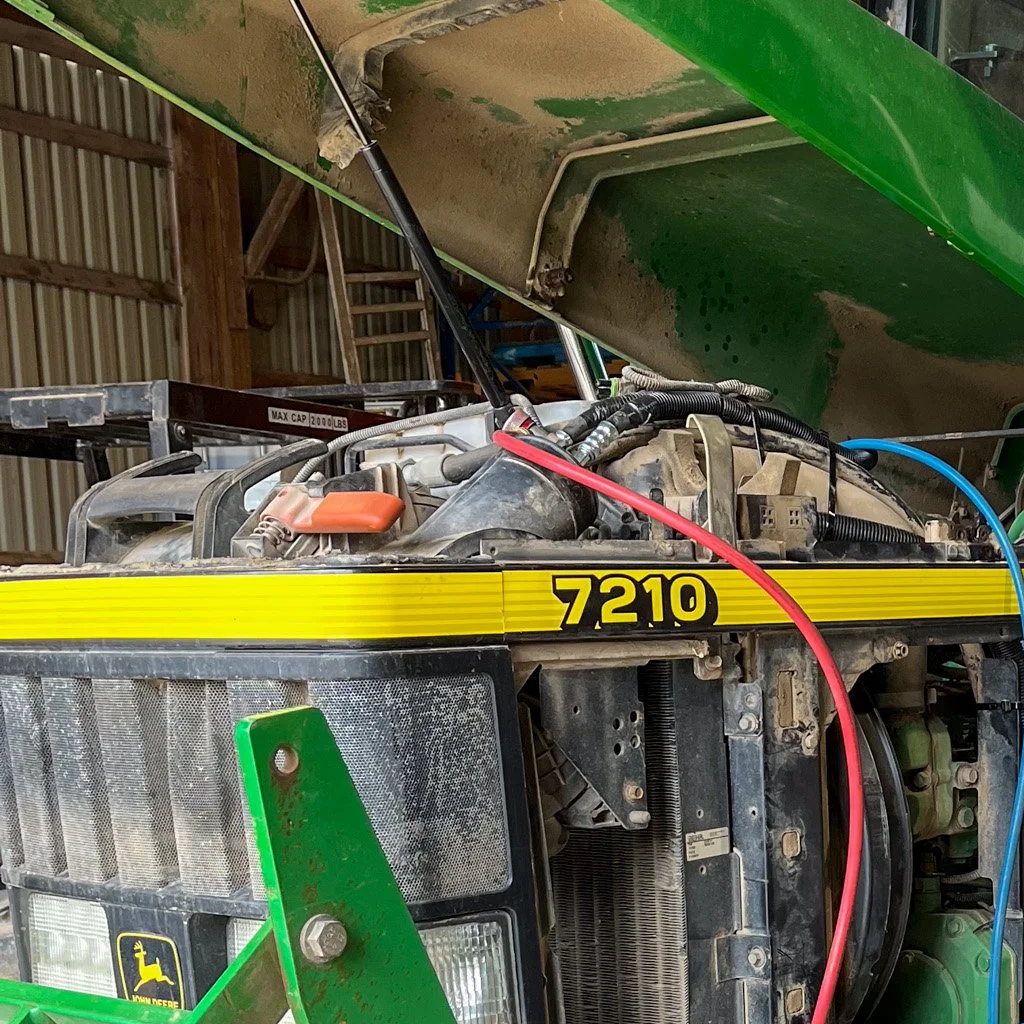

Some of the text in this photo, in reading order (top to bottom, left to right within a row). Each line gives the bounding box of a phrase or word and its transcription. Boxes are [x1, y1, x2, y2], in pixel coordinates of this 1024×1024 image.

[271, 410, 347, 429] MAX CAP 2000 LBS
[553, 575, 710, 626] 7210
